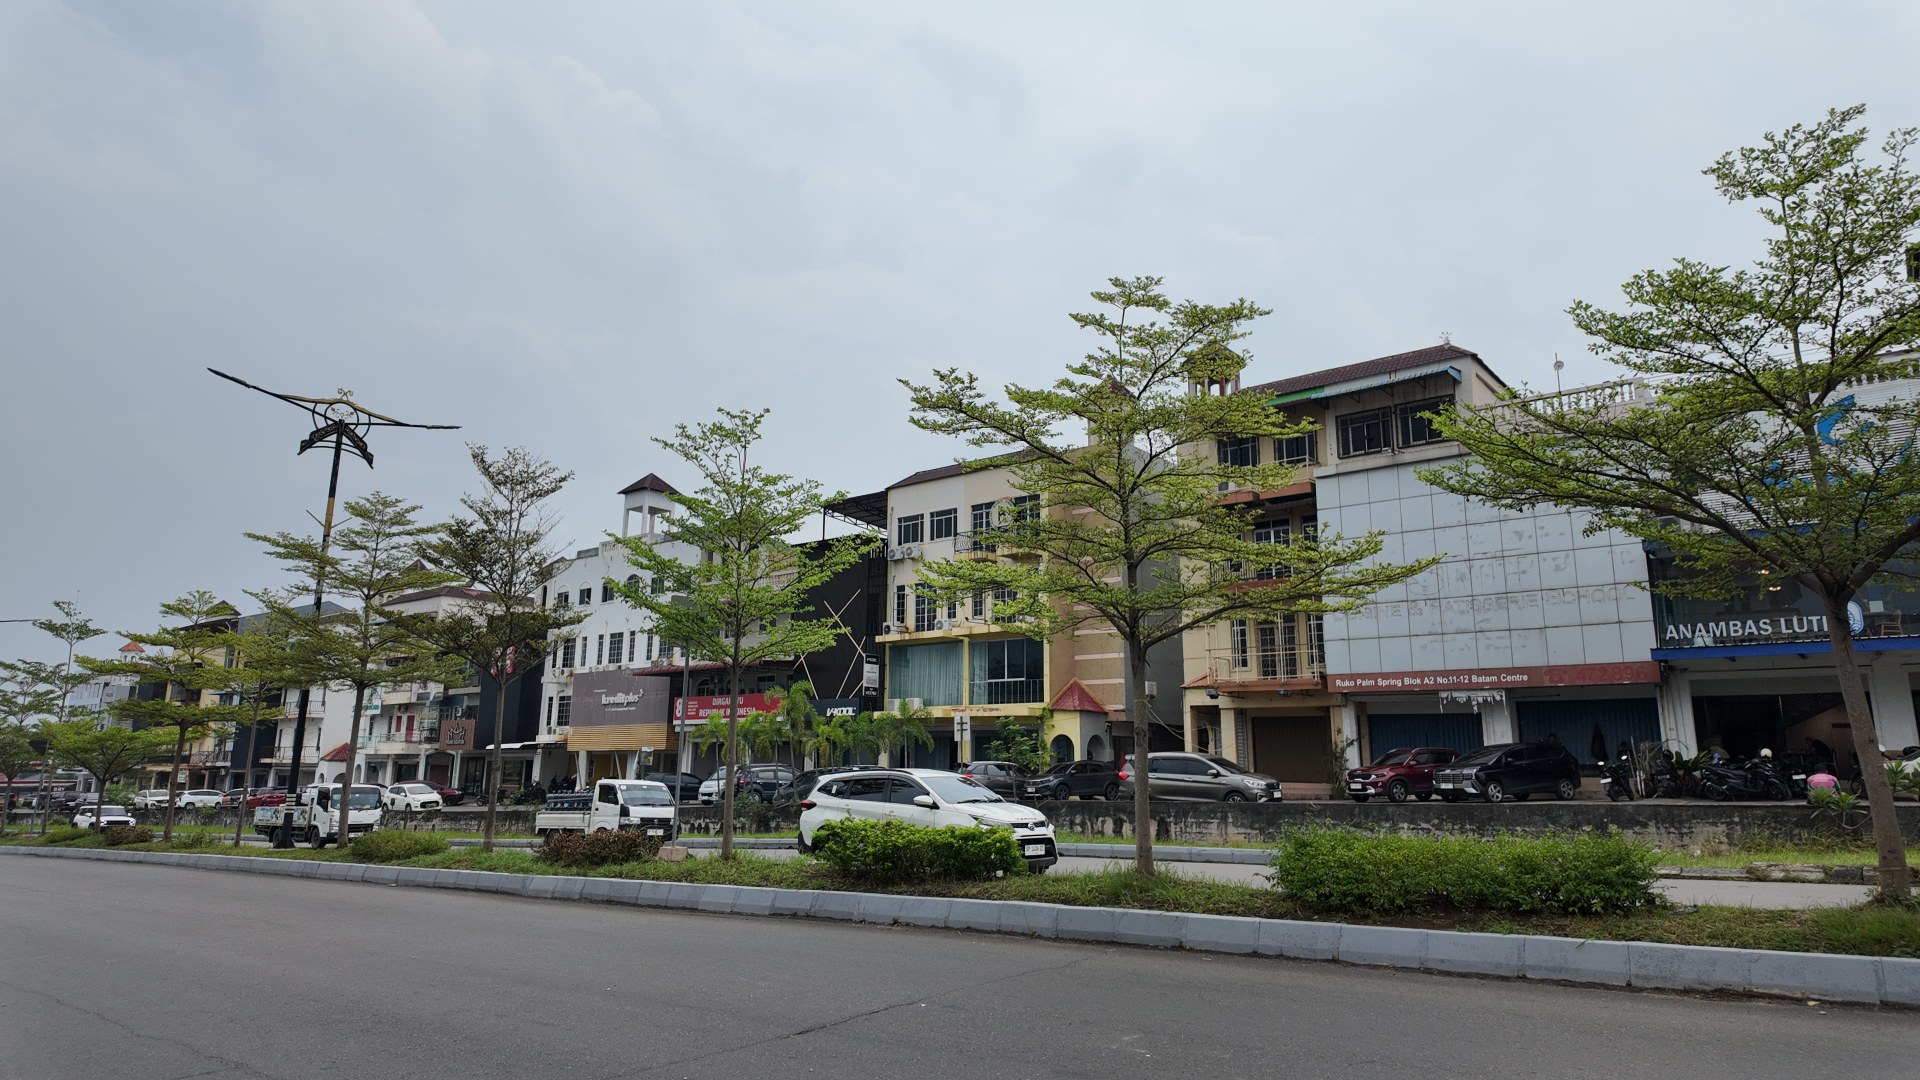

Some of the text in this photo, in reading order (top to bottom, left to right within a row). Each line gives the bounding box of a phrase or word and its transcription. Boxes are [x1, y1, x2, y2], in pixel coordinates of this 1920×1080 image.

[1665, 615, 1829, 641] ANAMBAS LUTI
[1335, 679, 1355, 687] Ruko
[1356, 678, 1375, 687] Palm
[1377, 677, 1402, 688] Spring
[1403, 676, 1421, 686] Blok
[1423, 676, 1435, 685] A2
[1471, 674, 1498, 683] Batam
[1500, 673, 1529, 682] Centre
